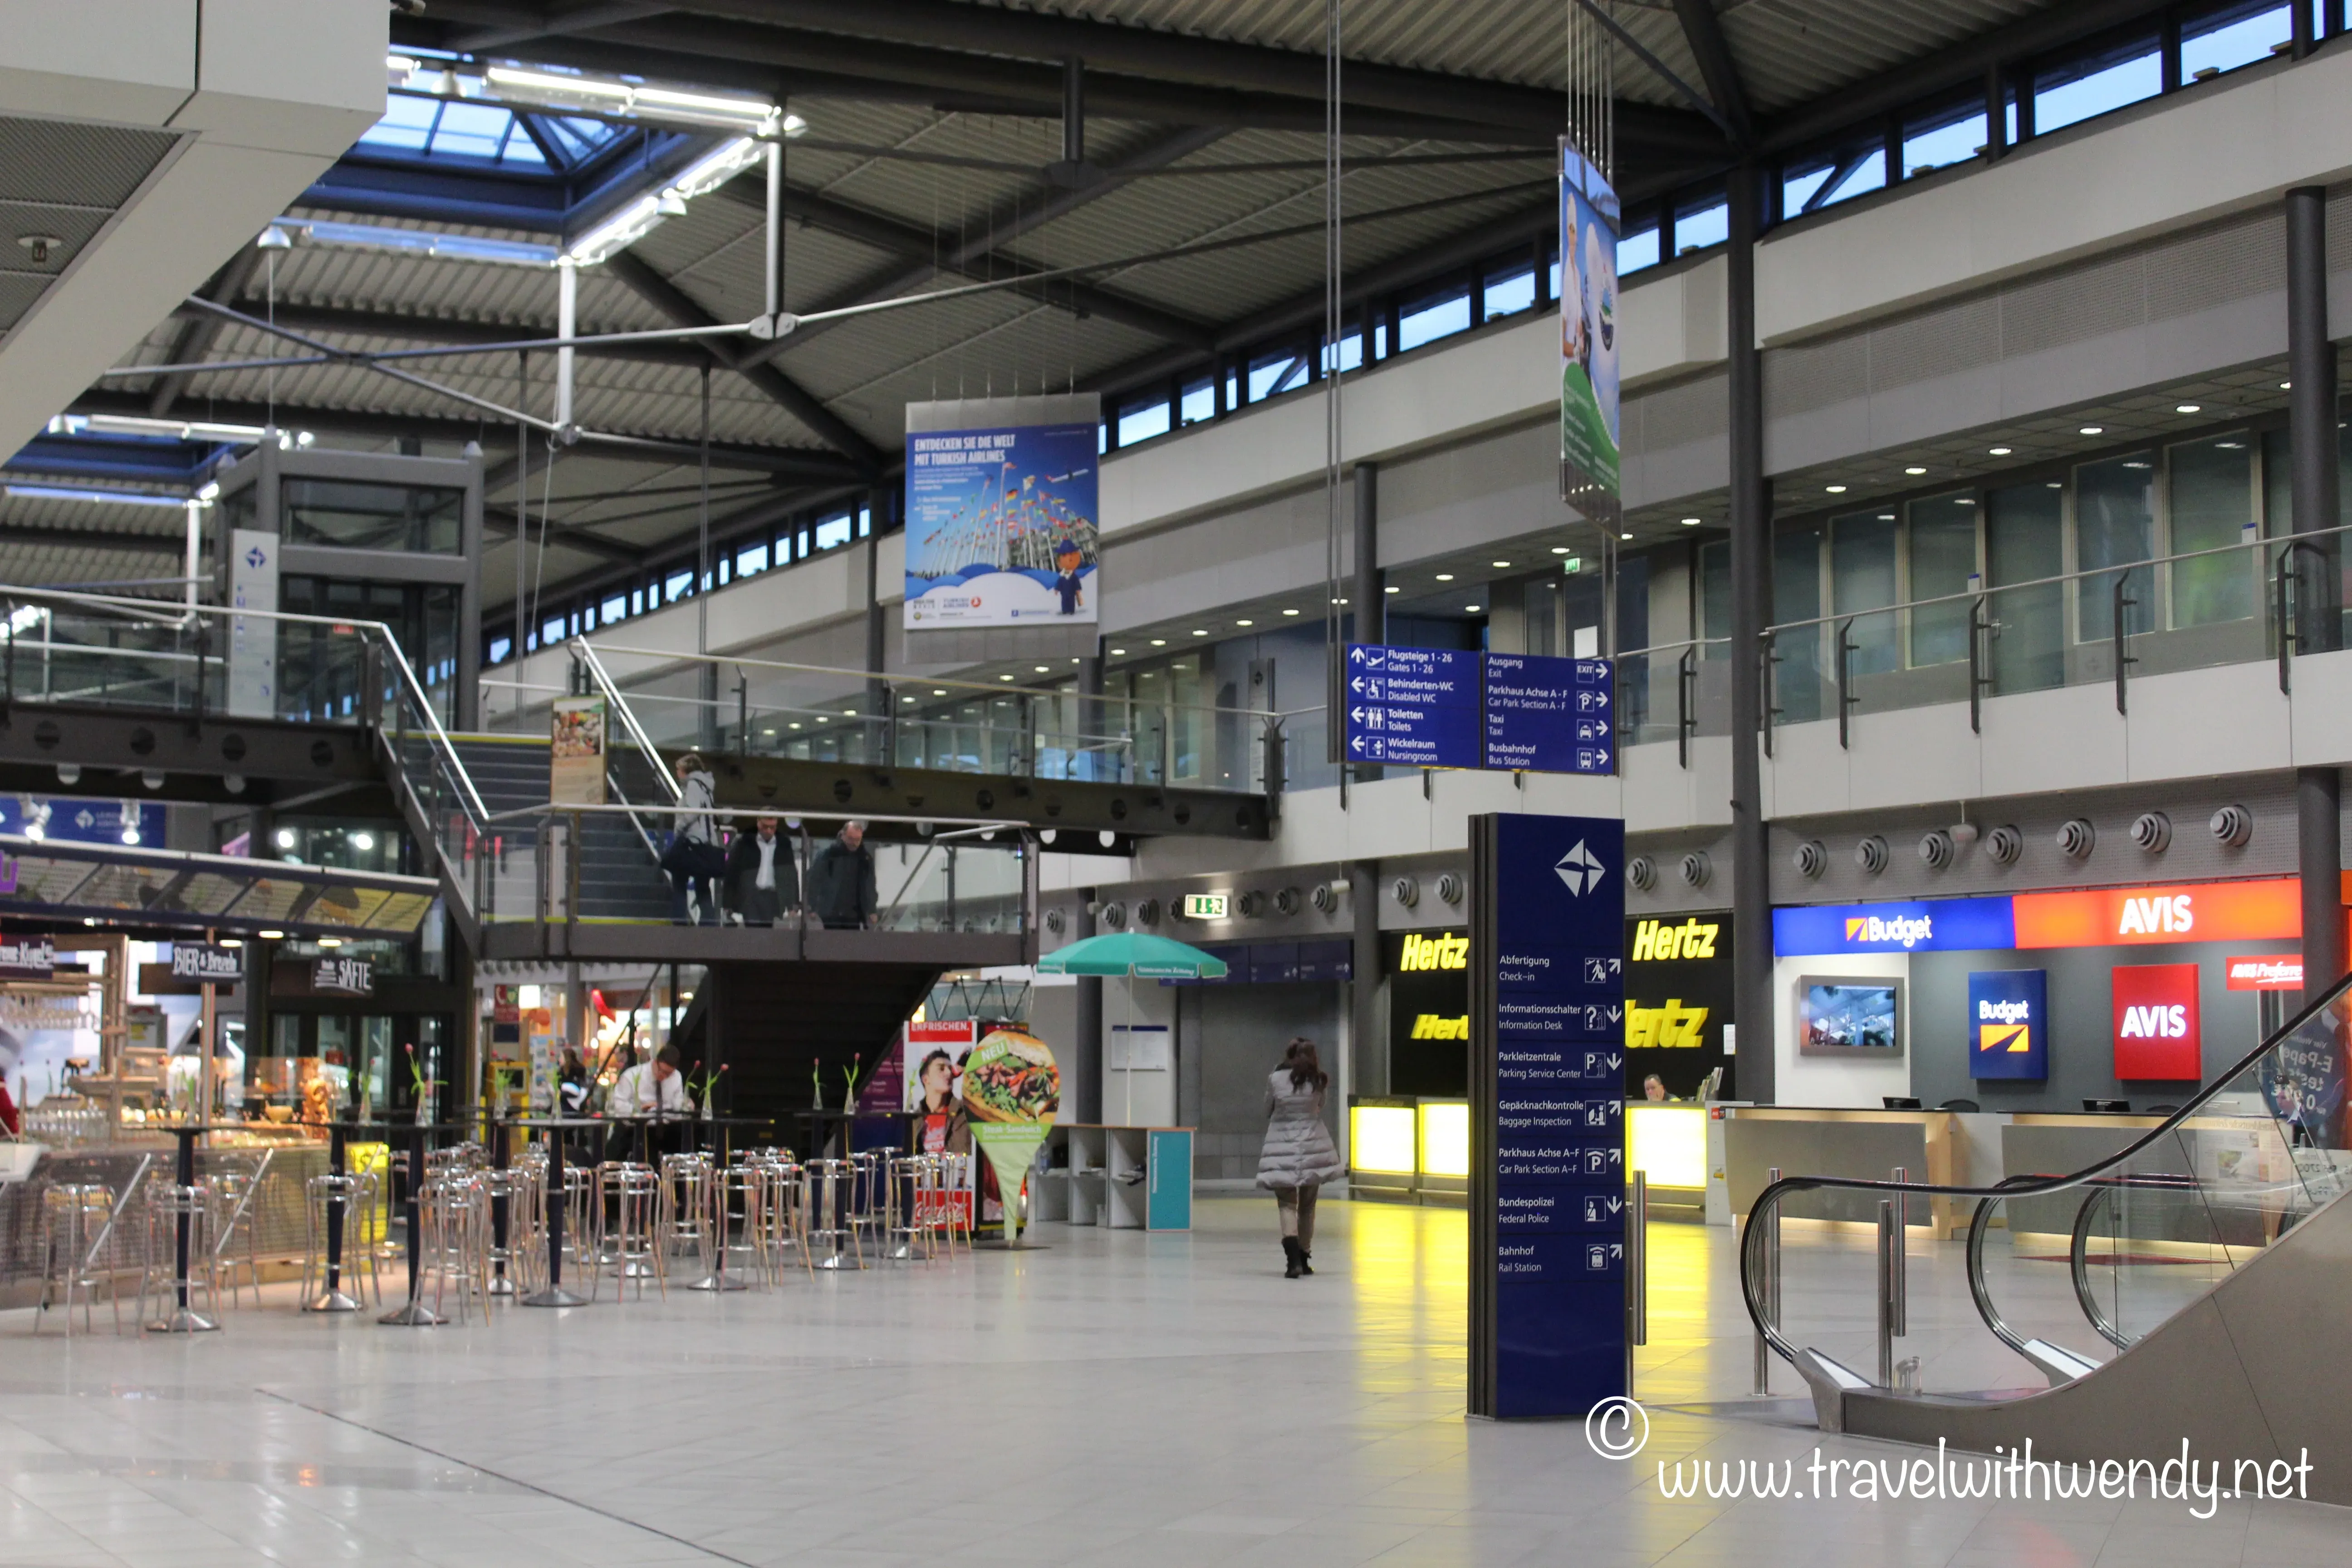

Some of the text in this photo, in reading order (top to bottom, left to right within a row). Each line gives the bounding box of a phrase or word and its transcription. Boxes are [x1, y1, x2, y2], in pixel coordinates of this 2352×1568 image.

[915, 434, 1015, 452] ENTDECKEN SIE DIE WELT
[914, 449, 1005, 466] MIT TURKISH AIRLINES
[1388, 649, 1429, 663] Flugsteige
[1431, 652, 1435, 662] 1
[1442, 653, 1452, 663] 26
[1388, 662, 1410, 672] Gates
[1412, 663, 1416, 672] 1
[1423, 664, 1433, 674] 26
[1488, 657, 1523, 669] Ausgang
[1488, 668, 1502, 678] Exit
[1577, 665, 1593, 674] EXIT
[1388, 678, 1454, 691] Behinderten-WC
[1388, 691, 1436, 703] Disabled WC
[1488, 685, 1524, 696] Parkhaus
[1525, 687, 1548, 698] Achse
[1550, 689, 1557, 698] A
[1563, 690, 1568, 699] F
[1488, 697, 1500, 706] Car
[1503, 698, 1519, 708] Park
[1521, 699, 1548, 710] Section
[1549, 701, 1556, 710] A
[1562, 702, 1566, 710] F
[1387, 708, 1423, 720] Toiletten
[1488, 714, 1504, 724] Taxi
[1387, 721, 1411, 731] Toilets
[1489, 726, 1503, 735] Taxi
[1388, 737, 1436, 749] Wickelraum
[1489, 743, 1536, 755] Busbahnhof
[1388, 750, 1437, 763] Nursingroom
[1489, 755, 1530, 766] Bus Station
[2119, 895, 2193, 934] AVIS
[1868, 915, 1932, 947] Budget
[1632, 918, 1719, 961] Hertz
[1400, 932, 1469, 971] Hertz
[172, 946, 200, 975] BIER
[1499, 955, 1550, 968] Abfertigung
[1499, 971, 1534, 981] Check-in
[2230, 961, 2303, 983] AVIS Preferre
[1499, 1003, 1581, 1014] Informationsschalter
[1979, 1000, 2029, 1024] Budget
[911, 1021, 969, 1031] ERFRISCHEN.
[1410, 1014, 1468, 1040] Hert
[1499, 1020, 1563, 1030] Information Desk
[1625, 999, 1709, 1048] ertz
[2120, 1004, 2185, 1038] AVIS
[981, 1043, 1005, 1062] NEU
[1499, 1051, 1561, 1061] Parkleitzentrale
[1499, 1068, 1581, 1080] Parking Service Center
[1499, 1100, 1584, 1112] Gepäcknachkontrolle
[1499, 1116, 1571, 1128] Baggage Inspection
[1499, 1147, 1535, 1157] Parkhaus
[1537, 1147, 1561, 1157] Achse
[1499, 1164, 1512, 1174] Car
[1514, 1164, 1530, 1174] Park
[1533, 1164, 1559, 1174] Section
[1499, 1197, 1554, 1209] Bundespolizei
[1499, 1213, 1549, 1224] Federal Police
[1499, 1245, 1534, 1256] Bahnhof
[1499, 1262, 1541, 1272] Rail Station
